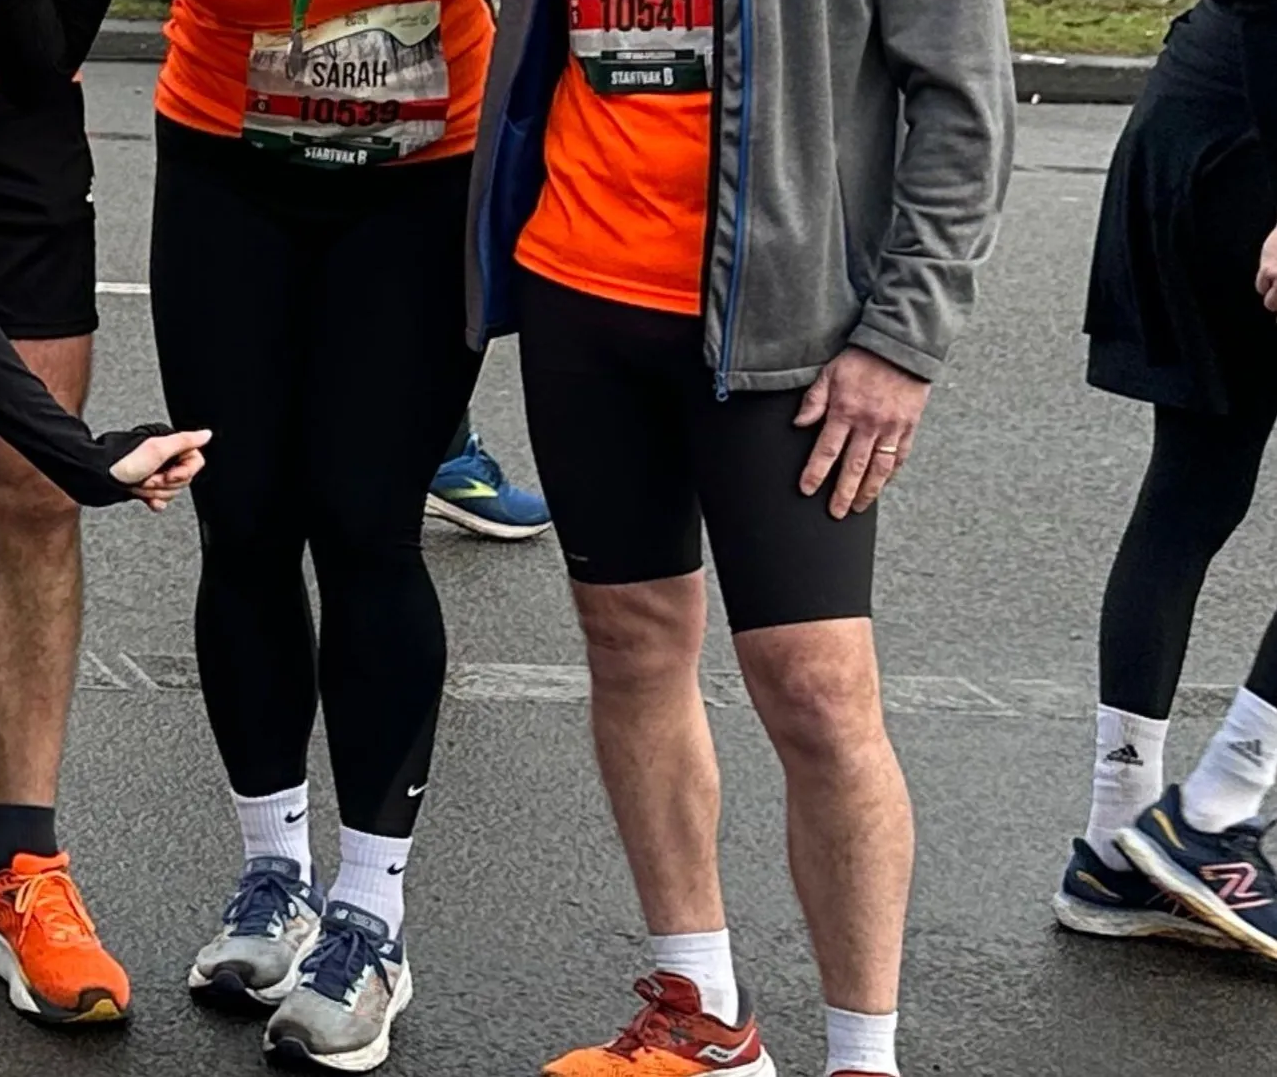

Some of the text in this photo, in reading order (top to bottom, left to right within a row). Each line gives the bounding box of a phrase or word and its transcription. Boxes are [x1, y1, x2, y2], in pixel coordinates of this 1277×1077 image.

[311, 60, 388, 88] SARAH
[663, 67, 674, 86] B
[298, 95, 400, 127] 10539
[357, 149, 368, 165] B
